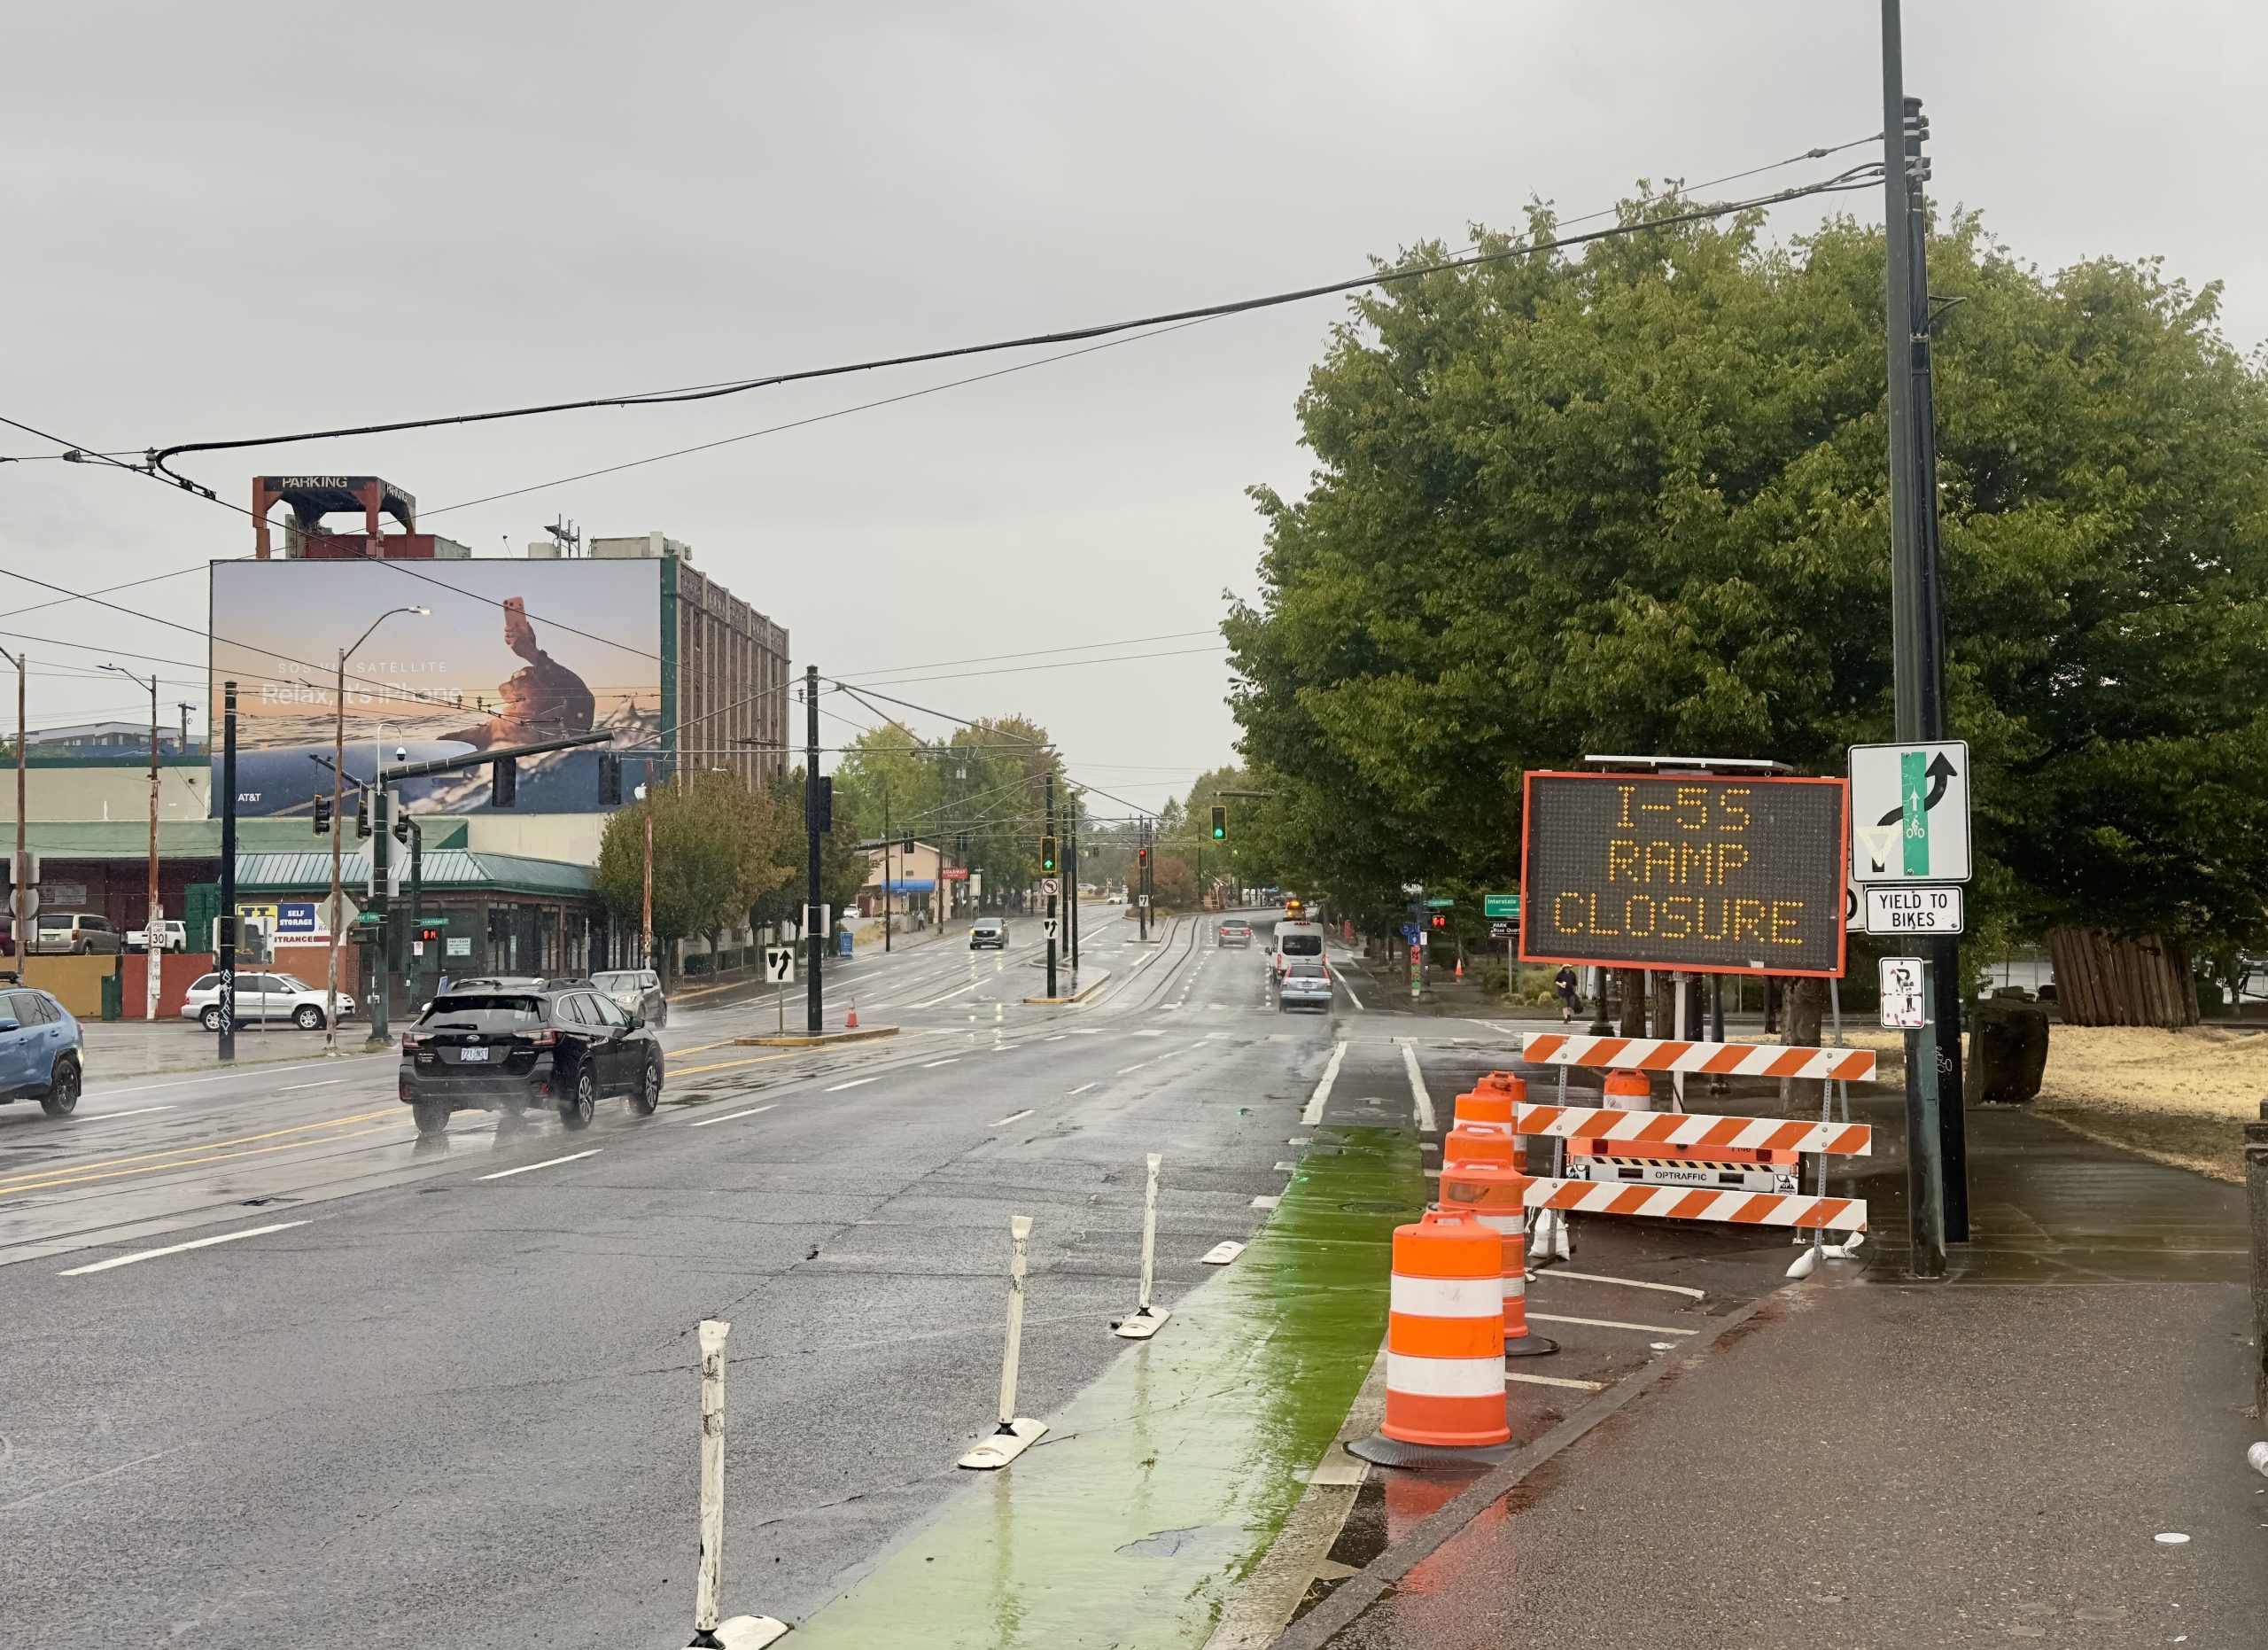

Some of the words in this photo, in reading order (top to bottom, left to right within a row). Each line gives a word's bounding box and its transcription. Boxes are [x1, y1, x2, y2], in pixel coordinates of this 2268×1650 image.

[282, 476, 347, 487] PARKING
[278, 662, 311, 673] SOS
[356, 661, 447, 673] SATELLITE
[260, 682, 333, 708] Relax,
[341, 682, 373, 704] t's
[378, 682, 464, 705] iPhone
[237, 792, 261, 802] AT&T
[1609, 840, 1749, 885] RAMP
[1879, 894, 1922, 909] YIELD
[1930, 893, 1947, 908] TO
[1555, 891, 1805, 945] CLOSURE
[1892, 912, 1935, 927] BIKES
[152, 933, 165, 944] 30
[1655, 1171, 1707, 1181] OPTRAFFIC
